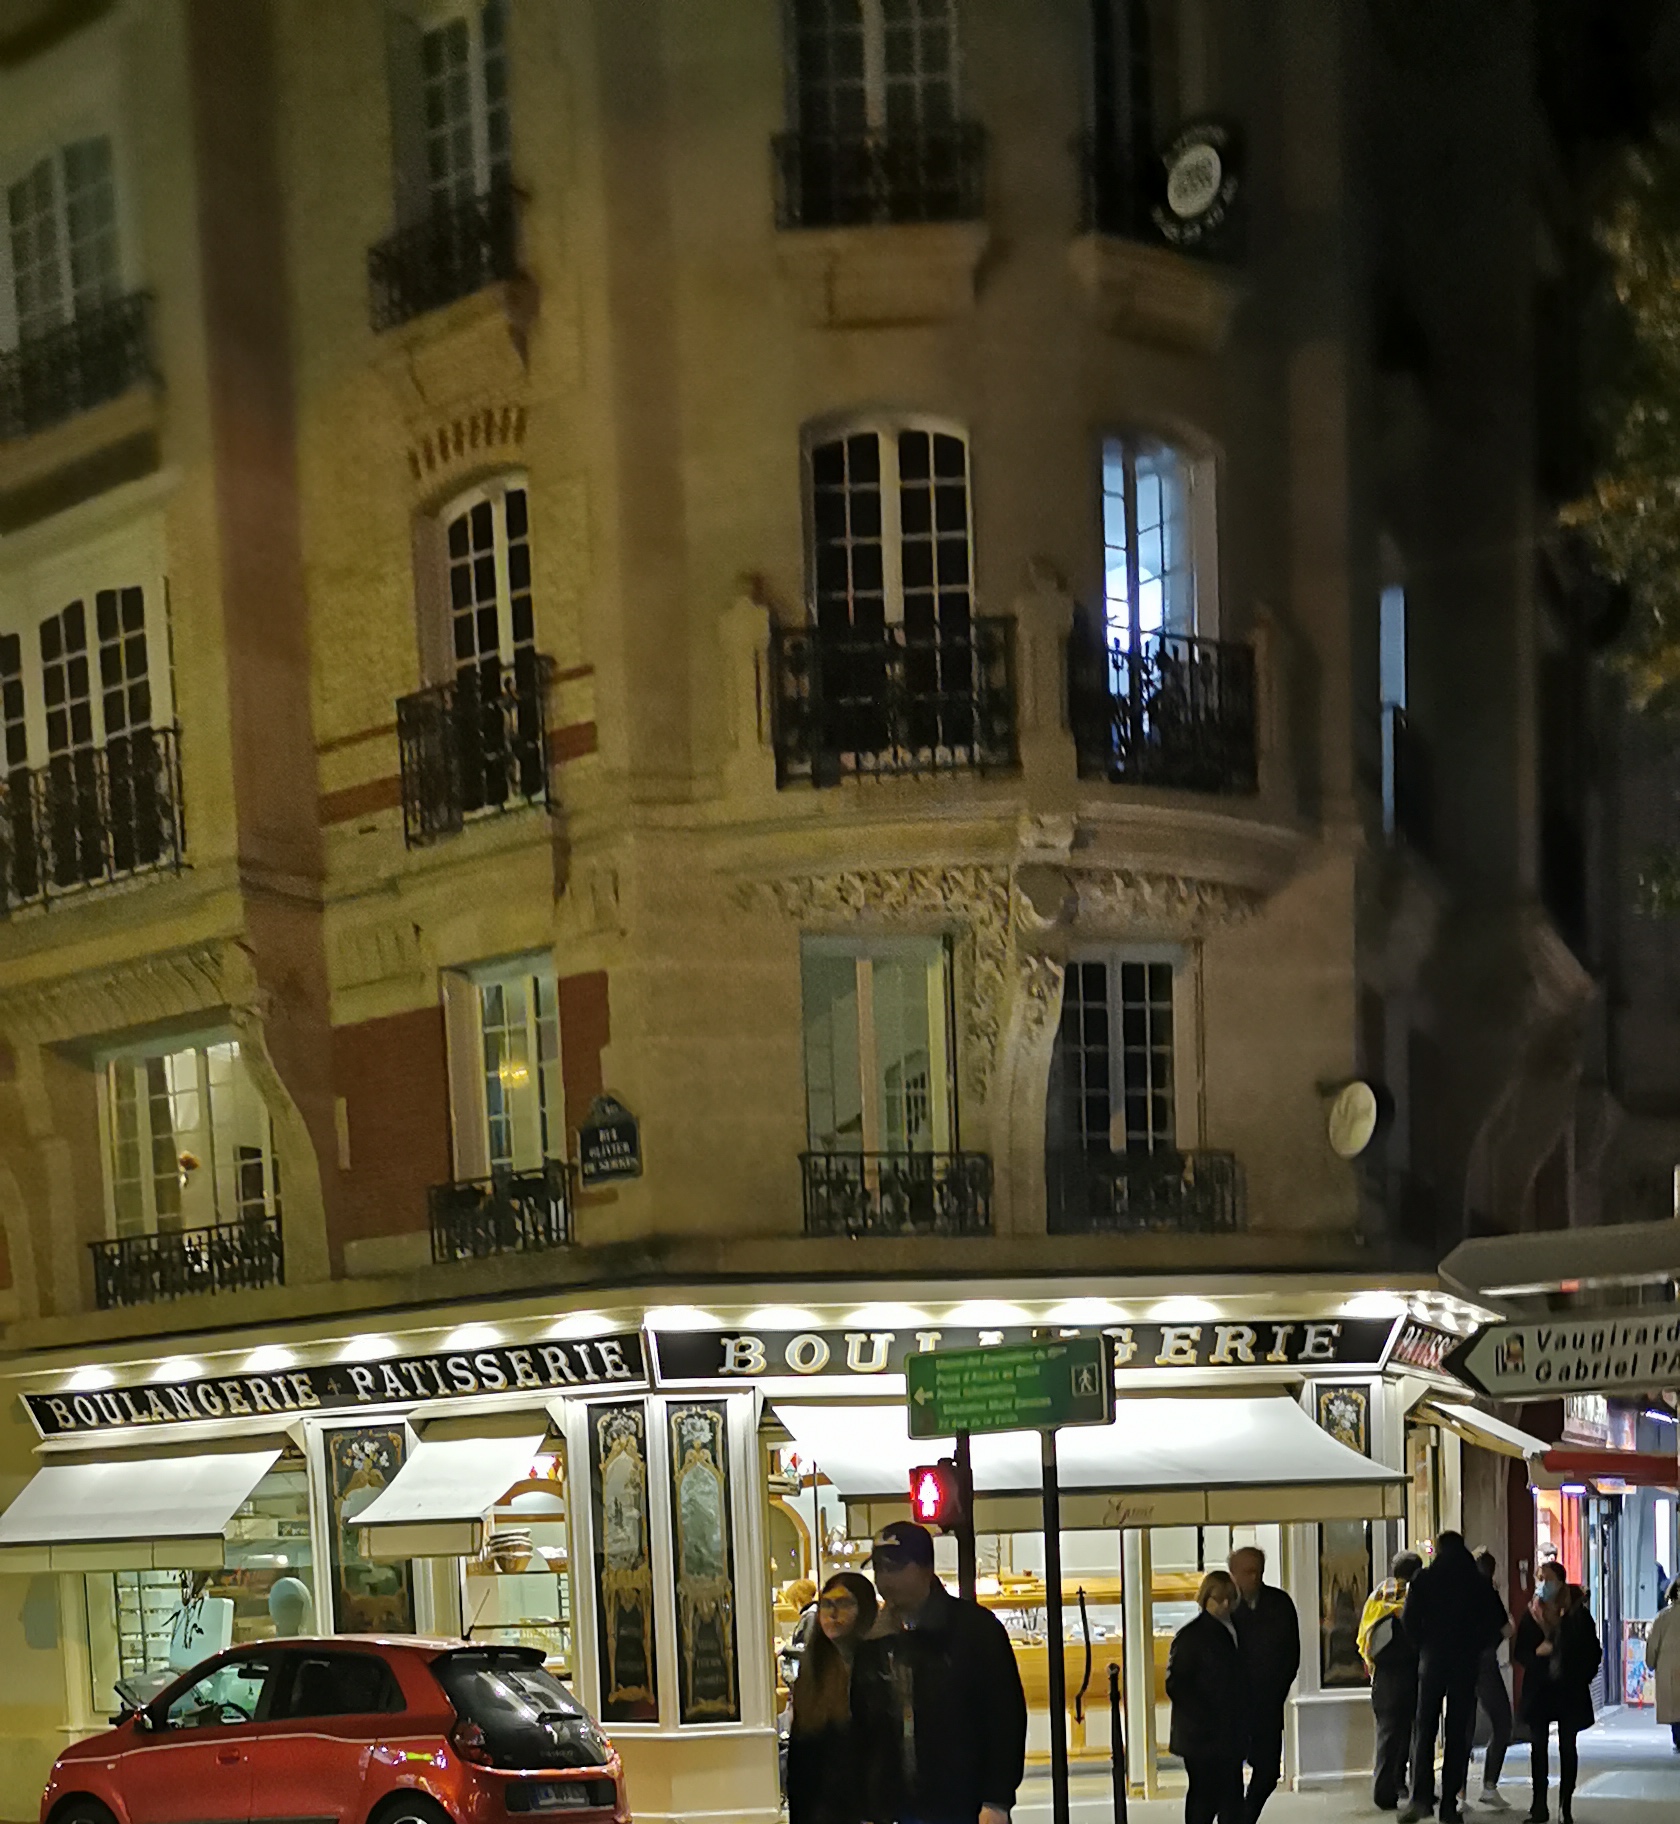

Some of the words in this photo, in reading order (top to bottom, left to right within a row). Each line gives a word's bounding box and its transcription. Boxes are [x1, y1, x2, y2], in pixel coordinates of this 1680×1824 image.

[719, 1323, 1343, 1375] BOUGERIE
[1537, 1318, 1680, 1353] Vaugirard
[45, 1373, 321, 1429] BOULANGERIE
[346, 1340, 632, 1401] PATISSERIE
[1534, 1351, 1639, 1384] Gabriel
